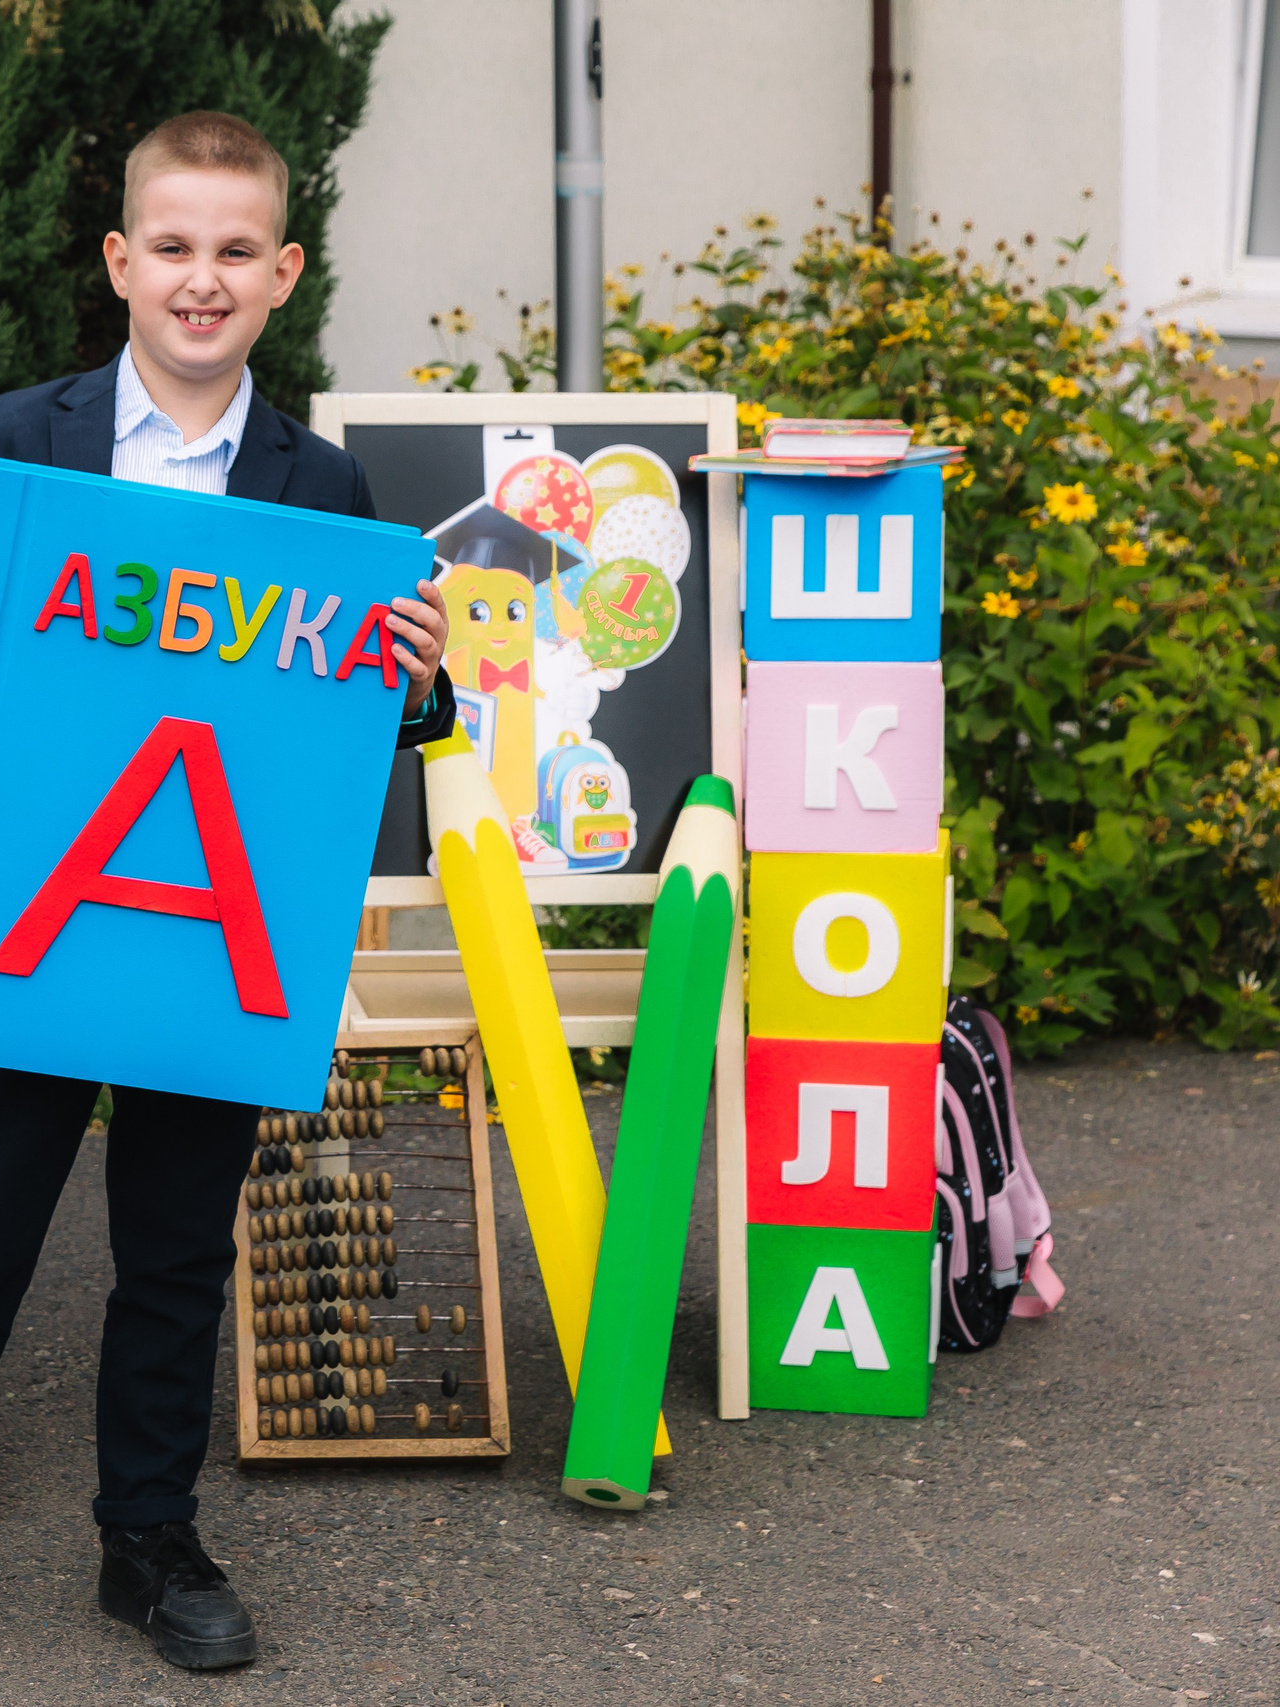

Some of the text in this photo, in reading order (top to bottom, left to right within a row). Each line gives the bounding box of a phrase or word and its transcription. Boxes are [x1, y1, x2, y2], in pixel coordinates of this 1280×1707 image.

[33, 552, 399, 689] АЗБУКА
[585, 571, 660, 643] 1 СЕНТЯБРЯ
[770, 514, 914, 1370] ШКОЛА
